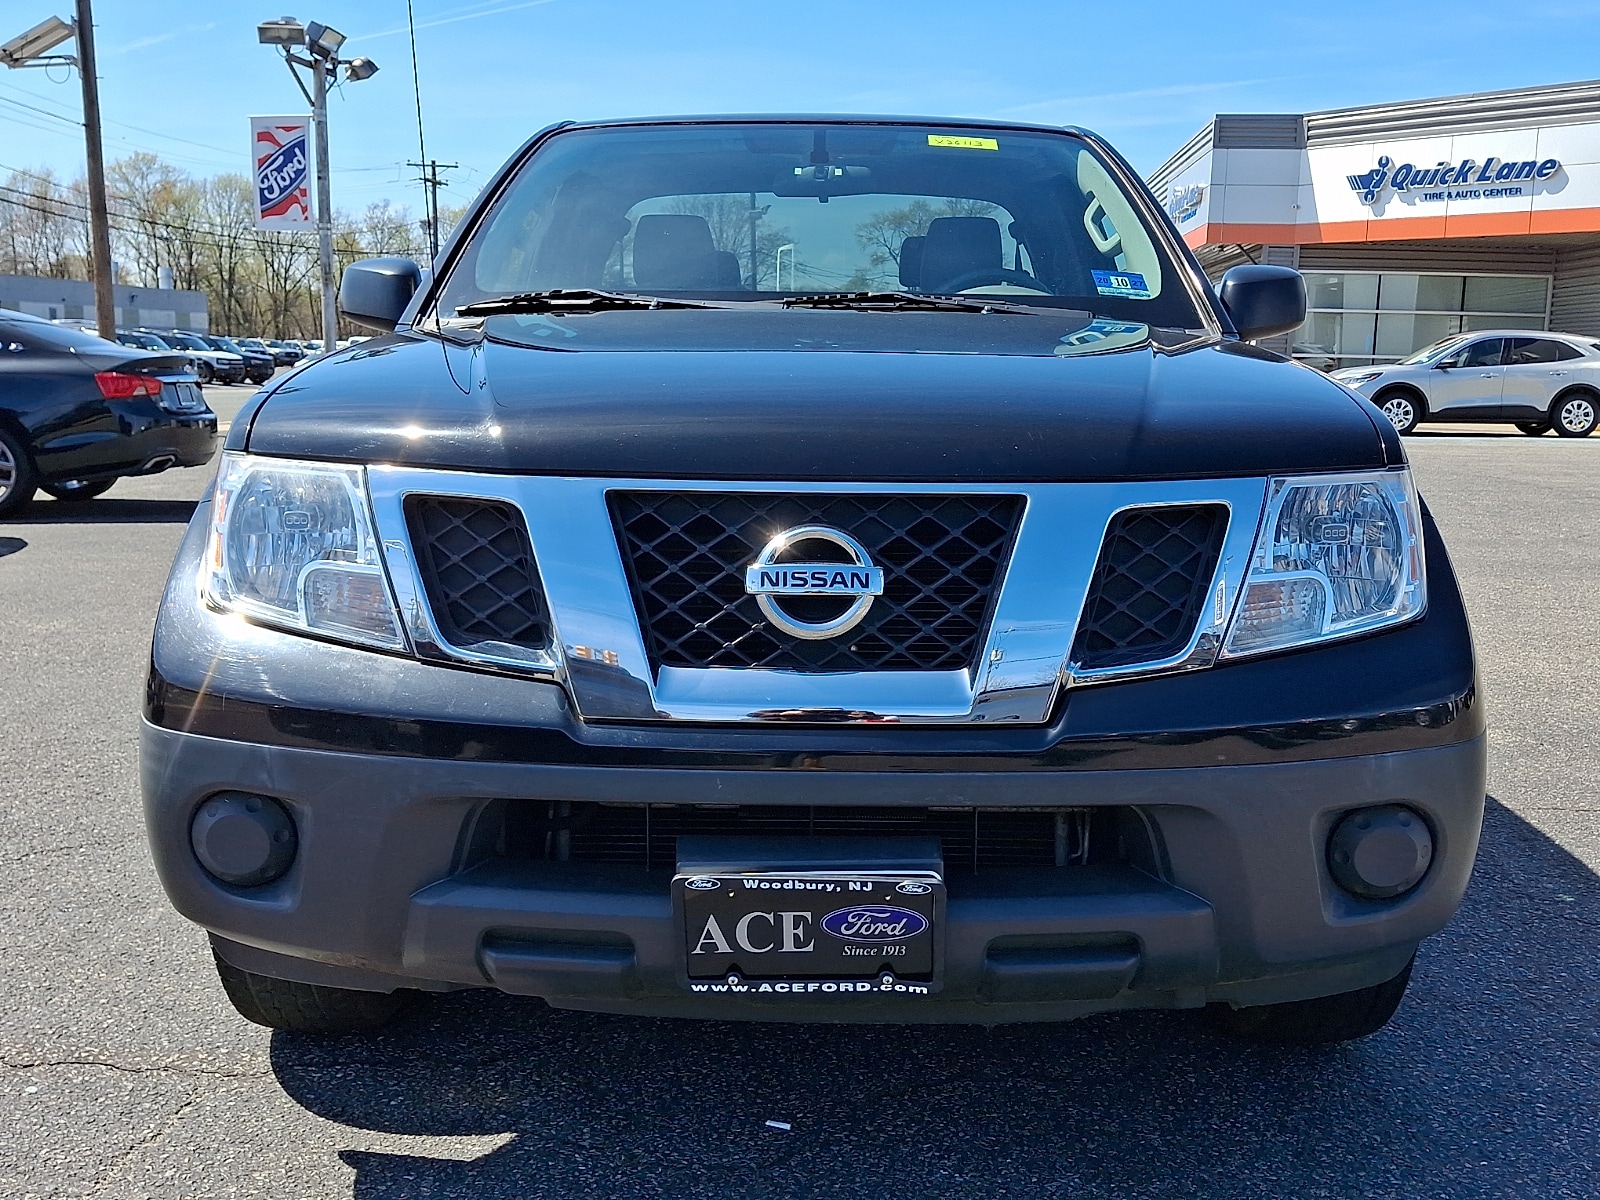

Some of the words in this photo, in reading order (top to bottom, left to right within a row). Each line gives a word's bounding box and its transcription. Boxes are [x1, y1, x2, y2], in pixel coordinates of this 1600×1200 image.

[258, 146, 305, 199] Ford
[1390, 159, 1476, 192] Quick
[1475, 157, 1560, 184] Lane
[1423, 192, 1445, 201] TIRE
[1446, 191, 1453, 200] &
[1454, 190, 1481, 199] AUTO
[1482, 187, 1522, 197] CENTER
[1114, 277, 1129, 287] 10
[760, 570, 870, 588] NISSAN
[743, 879, 841, 892] Woodbury,
[848, 881, 873, 891] NJ
[840, 911, 908, 935] Ford
[691, 911, 815, 954] ACE
[842, 946, 878, 956] Since
[881, 946, 906, 956] 1913
[691, 983, 928, 994] www.ACEFORD.com
